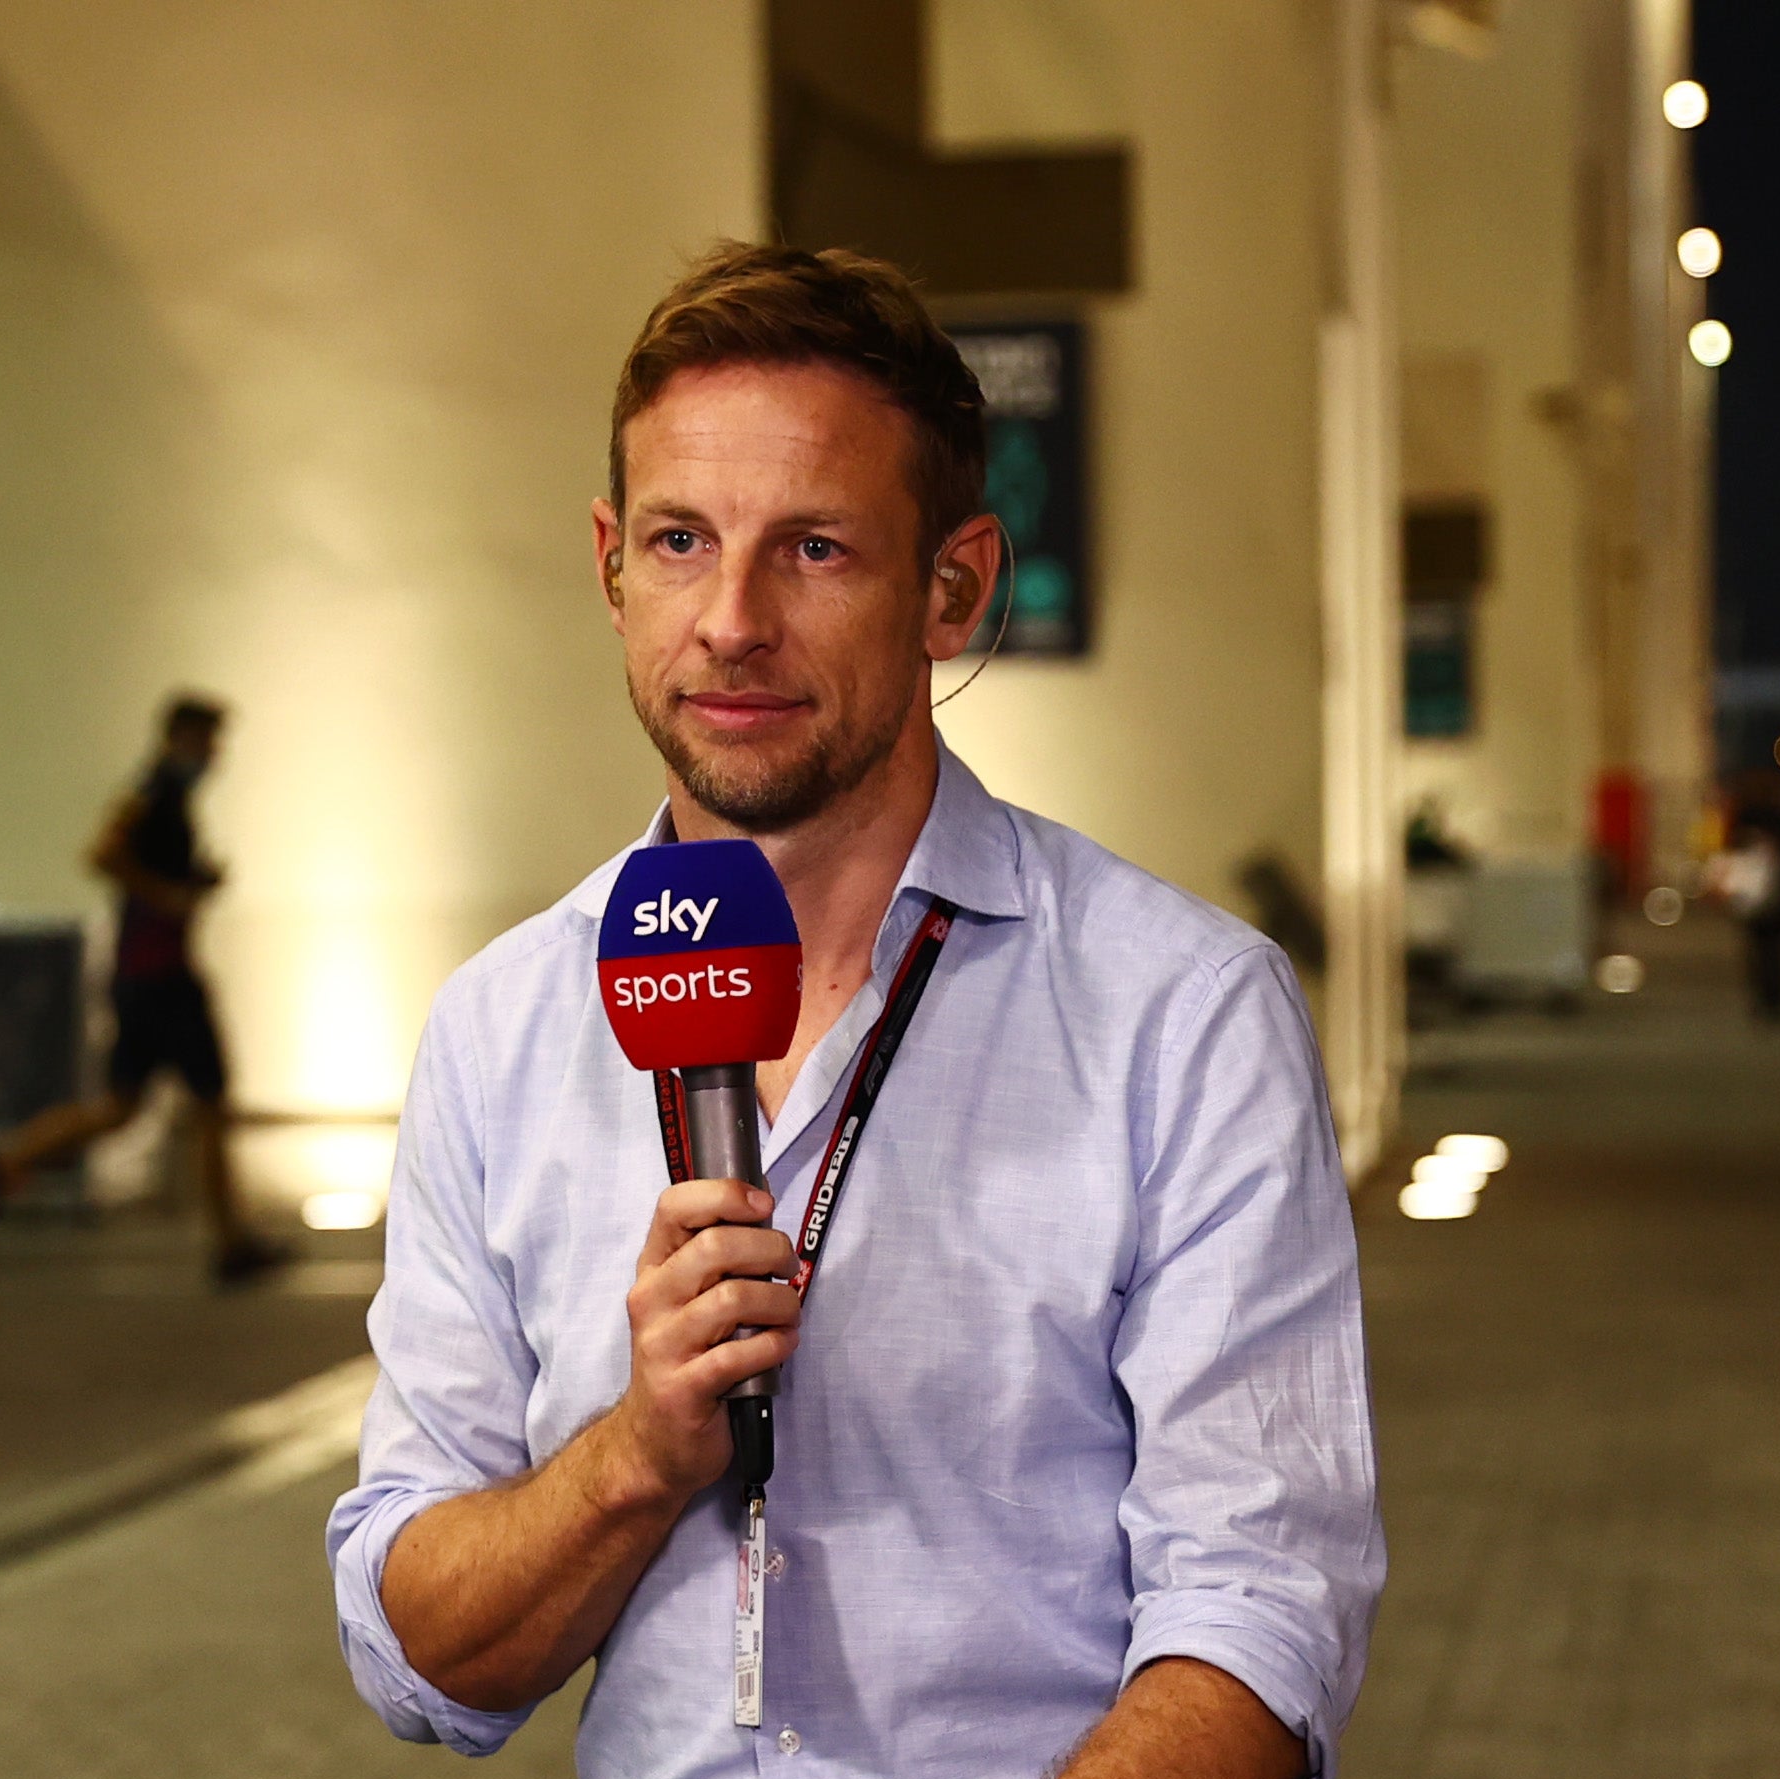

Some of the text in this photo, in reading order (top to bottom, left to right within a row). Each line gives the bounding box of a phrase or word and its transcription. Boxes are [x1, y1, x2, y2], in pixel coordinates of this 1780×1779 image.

[633, 889, 719, 942] sky
[612, 963, 753, 1014] sports
[803, 1129, 850, 1251] GRID PIT
